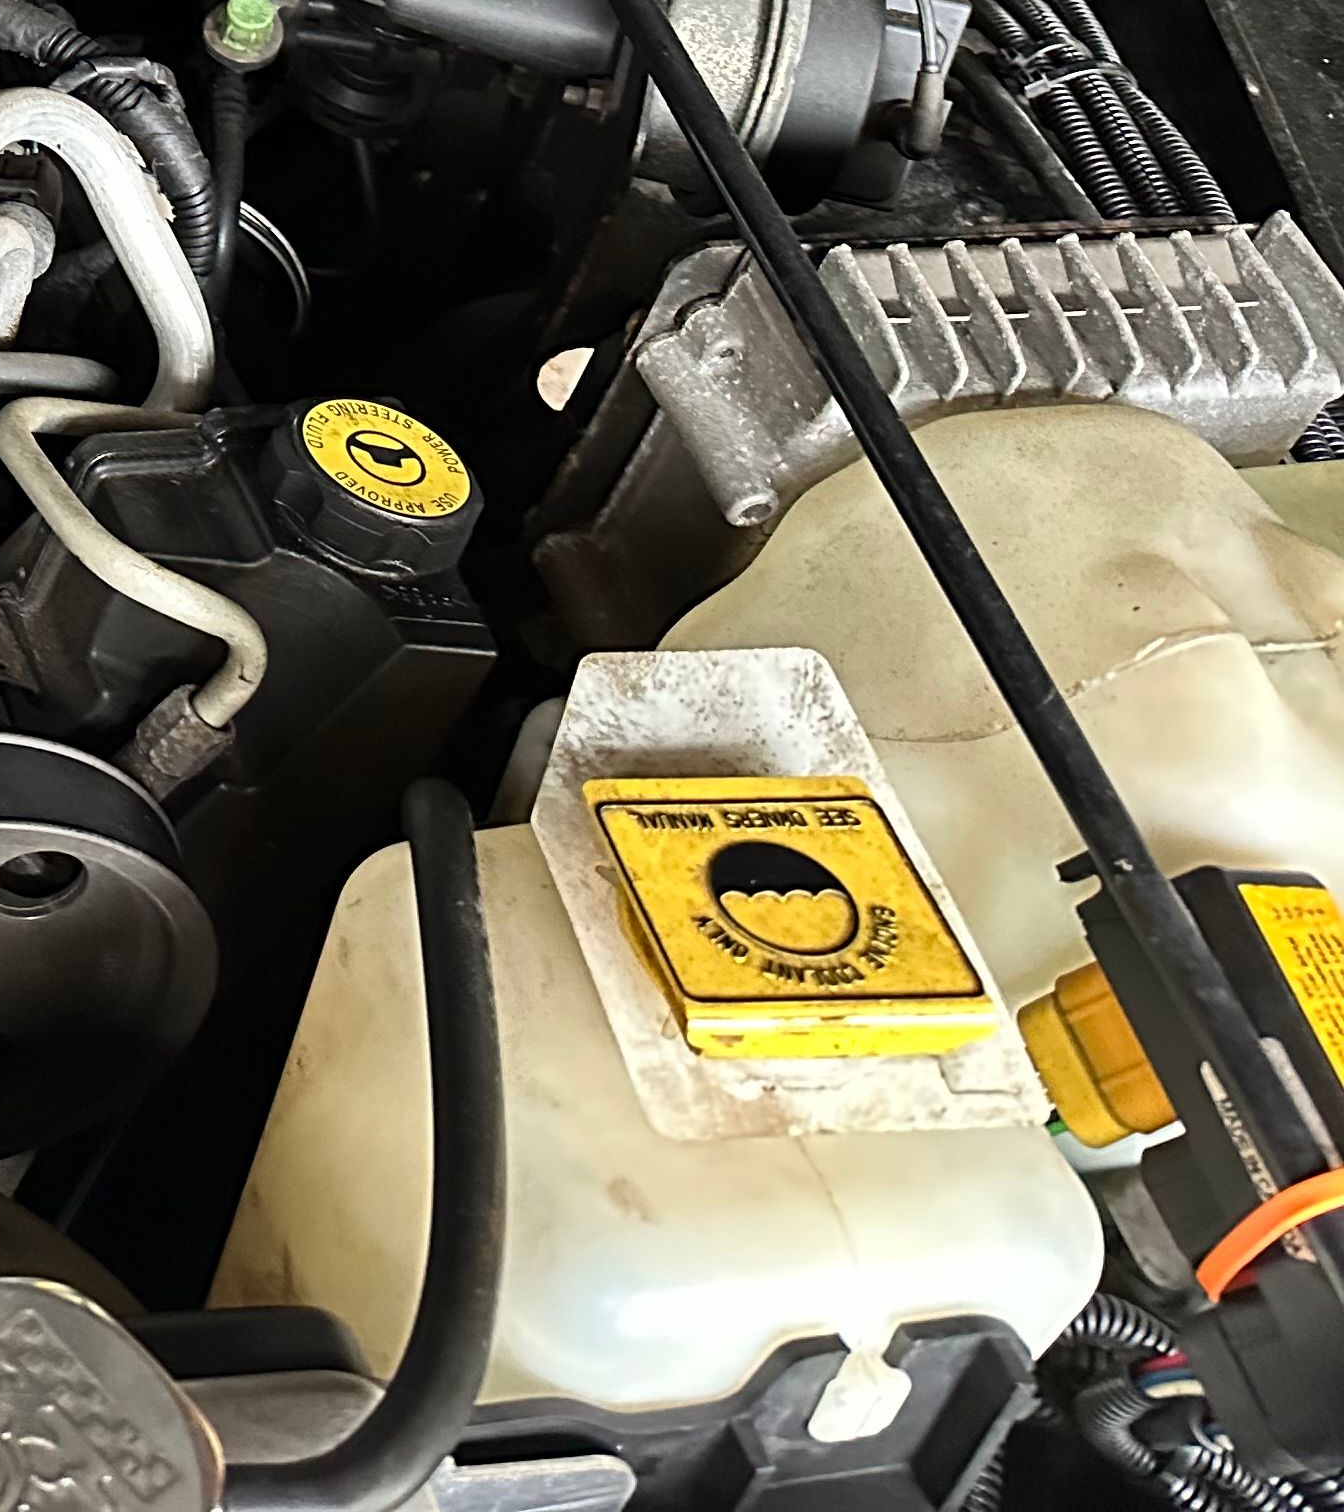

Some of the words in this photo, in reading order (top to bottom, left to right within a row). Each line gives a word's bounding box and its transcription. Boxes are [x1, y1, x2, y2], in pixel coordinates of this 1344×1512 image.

[307, 413, 329, 449] FLUID
[326, 402, 414, 430] STEERING
[423, 432, 464, 475] POWER
[335, 471, 426, 514] APPROVED
[431, 492, 460, 512] USE
[628, 810, 714, 831] MANUAL
[820, 809, 861, 831] SEE
[691, 914, 749, 965] ONLY
[862, 904, 897, 971] ENGINE
[761, 958, 866, 987] COOLANT
